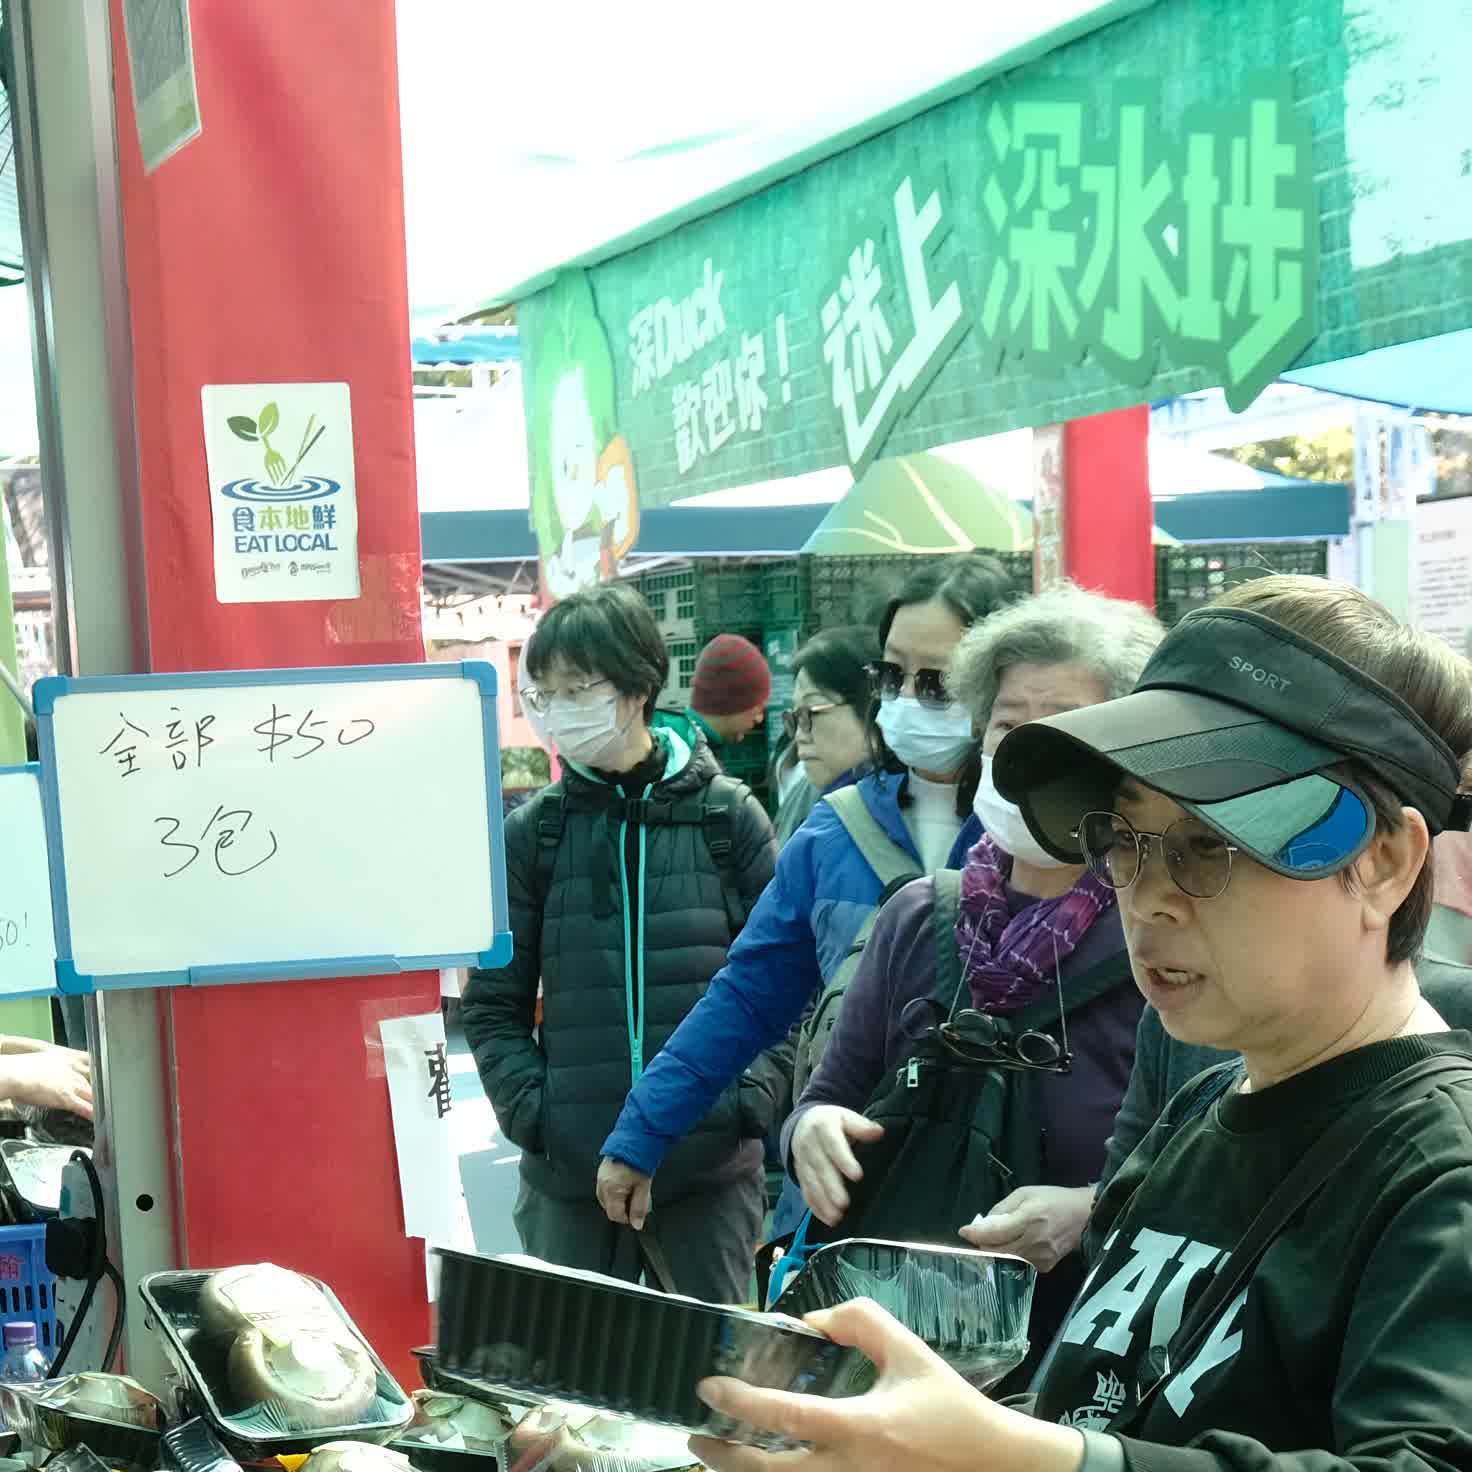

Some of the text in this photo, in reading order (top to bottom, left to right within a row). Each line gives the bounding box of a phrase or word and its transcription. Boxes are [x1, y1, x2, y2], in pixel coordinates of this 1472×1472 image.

[821, 98, 1305, 474] 迷上 深水埗
[232, 504, 336, 532] 食本地鮮
[235, 533, 339, 553] EAT LOCAL
[1230, 656, 1292, 692] SPORT
[99, 703, 375, 778] 全部 $50
[154, 805, 277, 877] 3包
